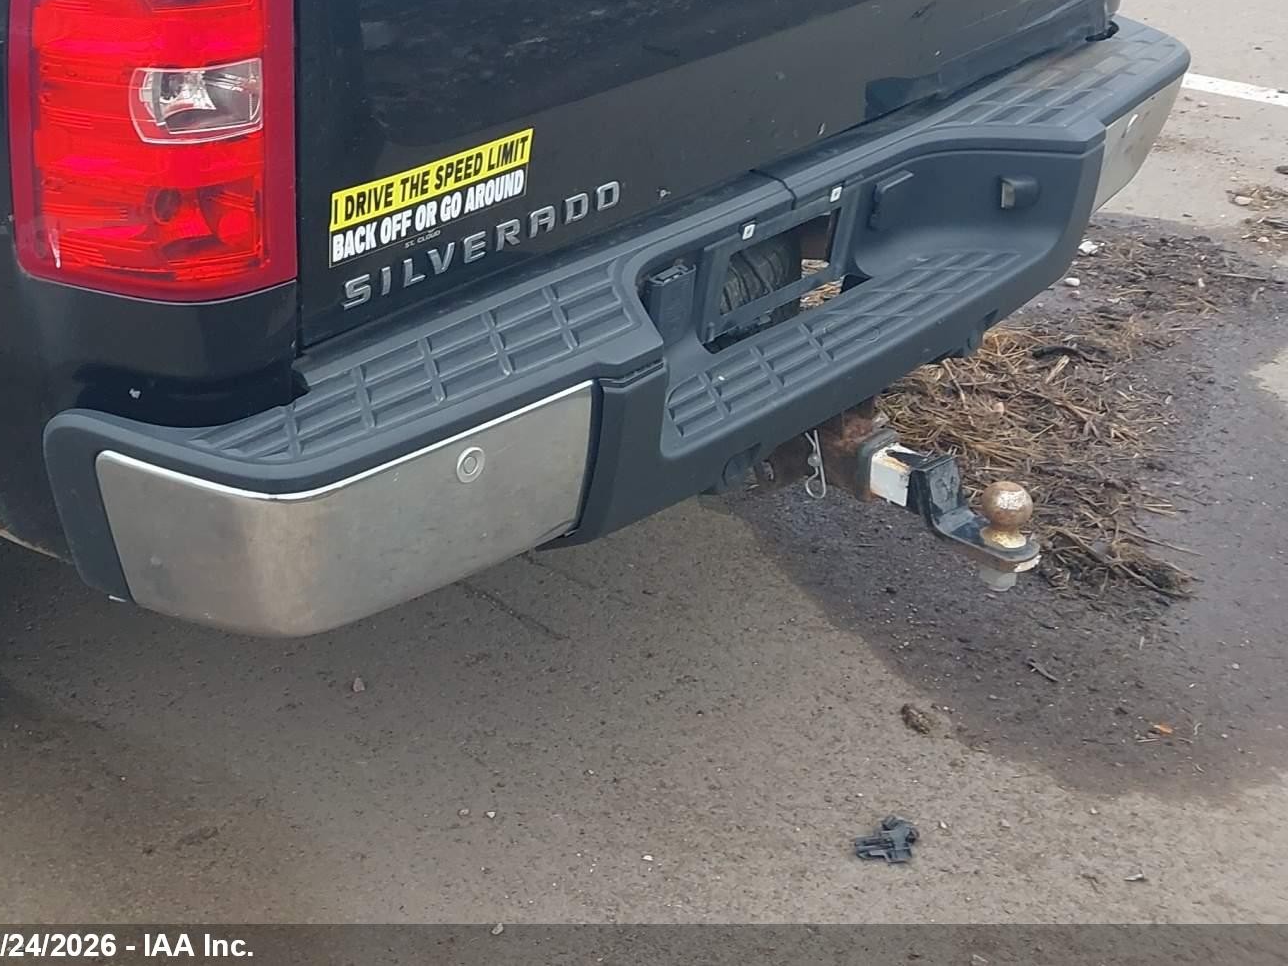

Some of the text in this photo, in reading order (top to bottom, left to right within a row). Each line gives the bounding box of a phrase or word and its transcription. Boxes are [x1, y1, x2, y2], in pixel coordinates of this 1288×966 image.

[332, 168, 526, 263] BACK OFF OR GO AROUND
[333, 135, 529, 225] I DRIVE THE SPEED LIMIT
[343, 180, 621, 310] SILVERADO
